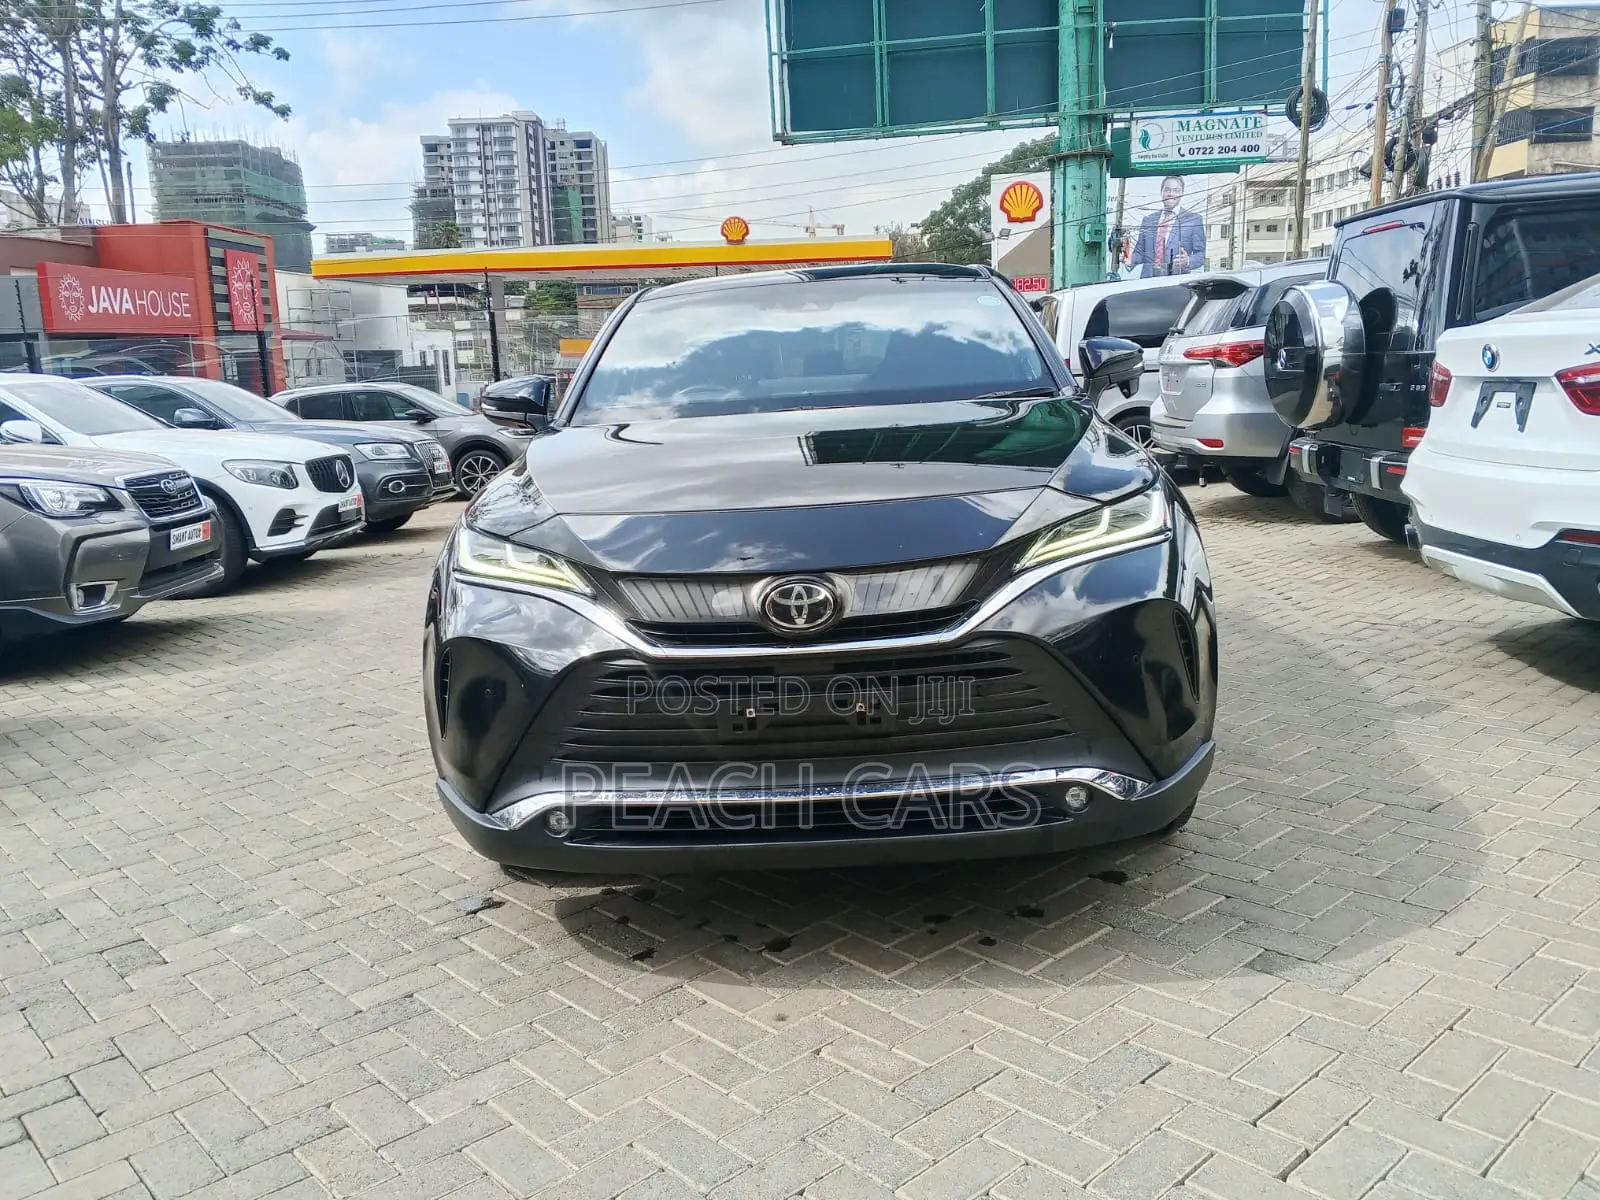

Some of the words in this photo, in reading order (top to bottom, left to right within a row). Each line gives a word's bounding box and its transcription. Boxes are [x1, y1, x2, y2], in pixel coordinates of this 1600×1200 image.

[1176, 116, 1263, 133] MAGNATE
[1175, 132, 1223, 143] VENTURES
[1188, 146, 1215, 156] 0722
[1217, 145, 1237, 155] 204
[1239, 143, 1260, 153] 400
[88, 285, 135, 314] JAVA
[134, 288, 192, 318] HOUSE
